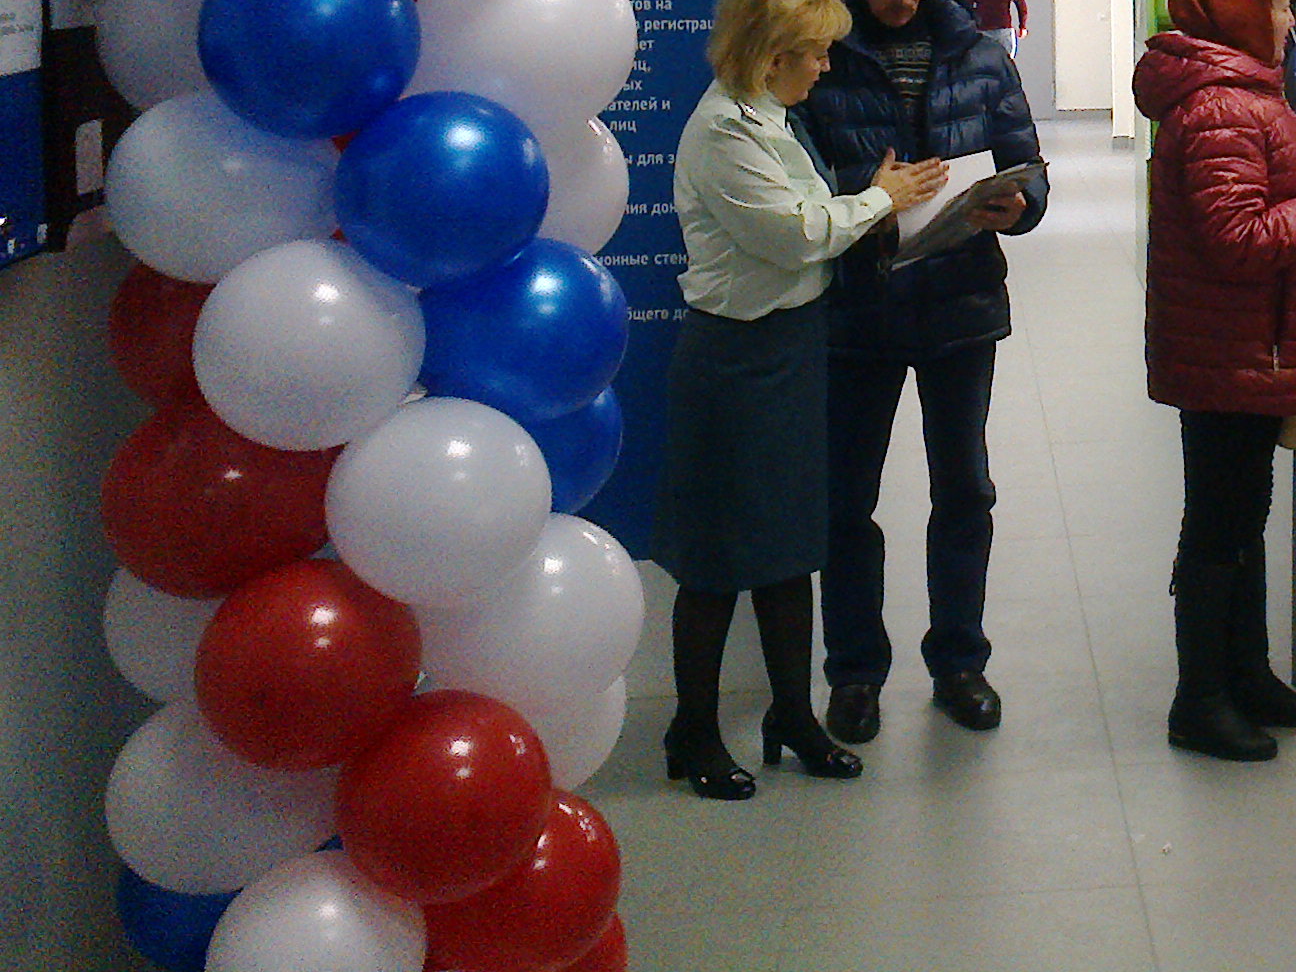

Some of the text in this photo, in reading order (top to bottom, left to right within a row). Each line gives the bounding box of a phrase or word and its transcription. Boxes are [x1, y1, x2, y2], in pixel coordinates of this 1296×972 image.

[655, 0, 673, 11] на
[604, 97, 671, 111] ателей и
[609, 120, 637, 133] лиц
[637, 153, 664, 167] для
